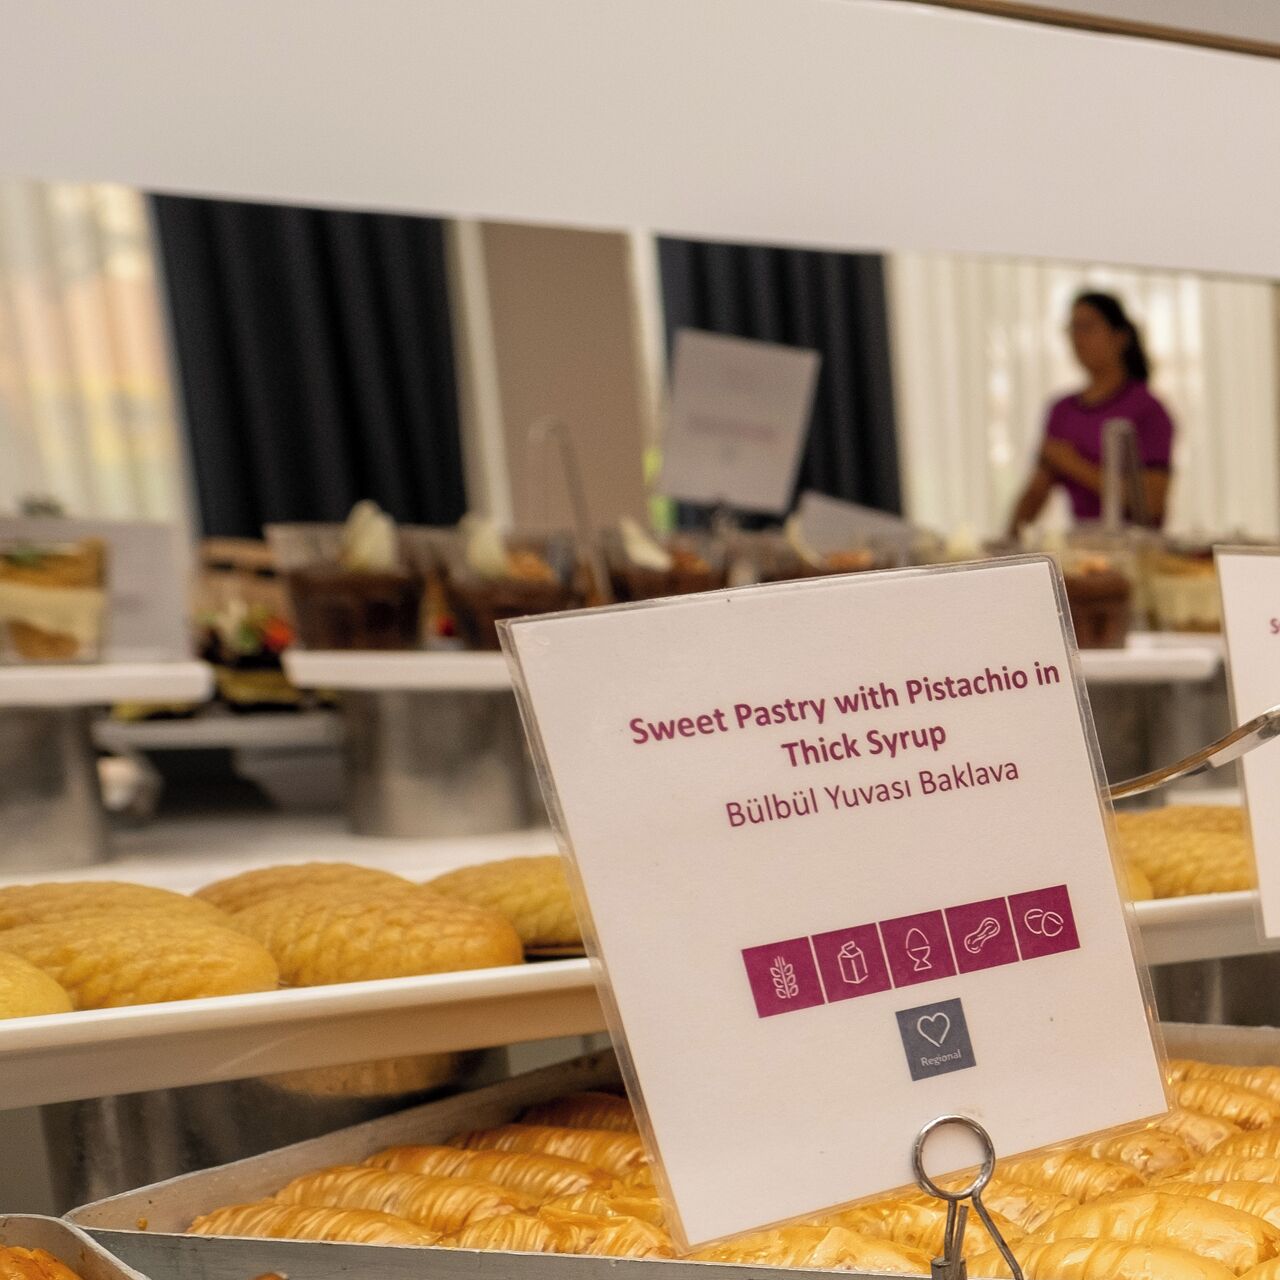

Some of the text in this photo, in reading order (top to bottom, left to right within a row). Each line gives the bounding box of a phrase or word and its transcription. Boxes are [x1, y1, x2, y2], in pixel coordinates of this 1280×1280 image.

[629, 661, 1061, 744] Sweet Pastry with Pistachio in
[781, 724, 947, 768] Thick Syrup
[725, 761, 1020, 828] Bülbül Yuvası Baklava
[921, 1049, 962, 1067] Regional
